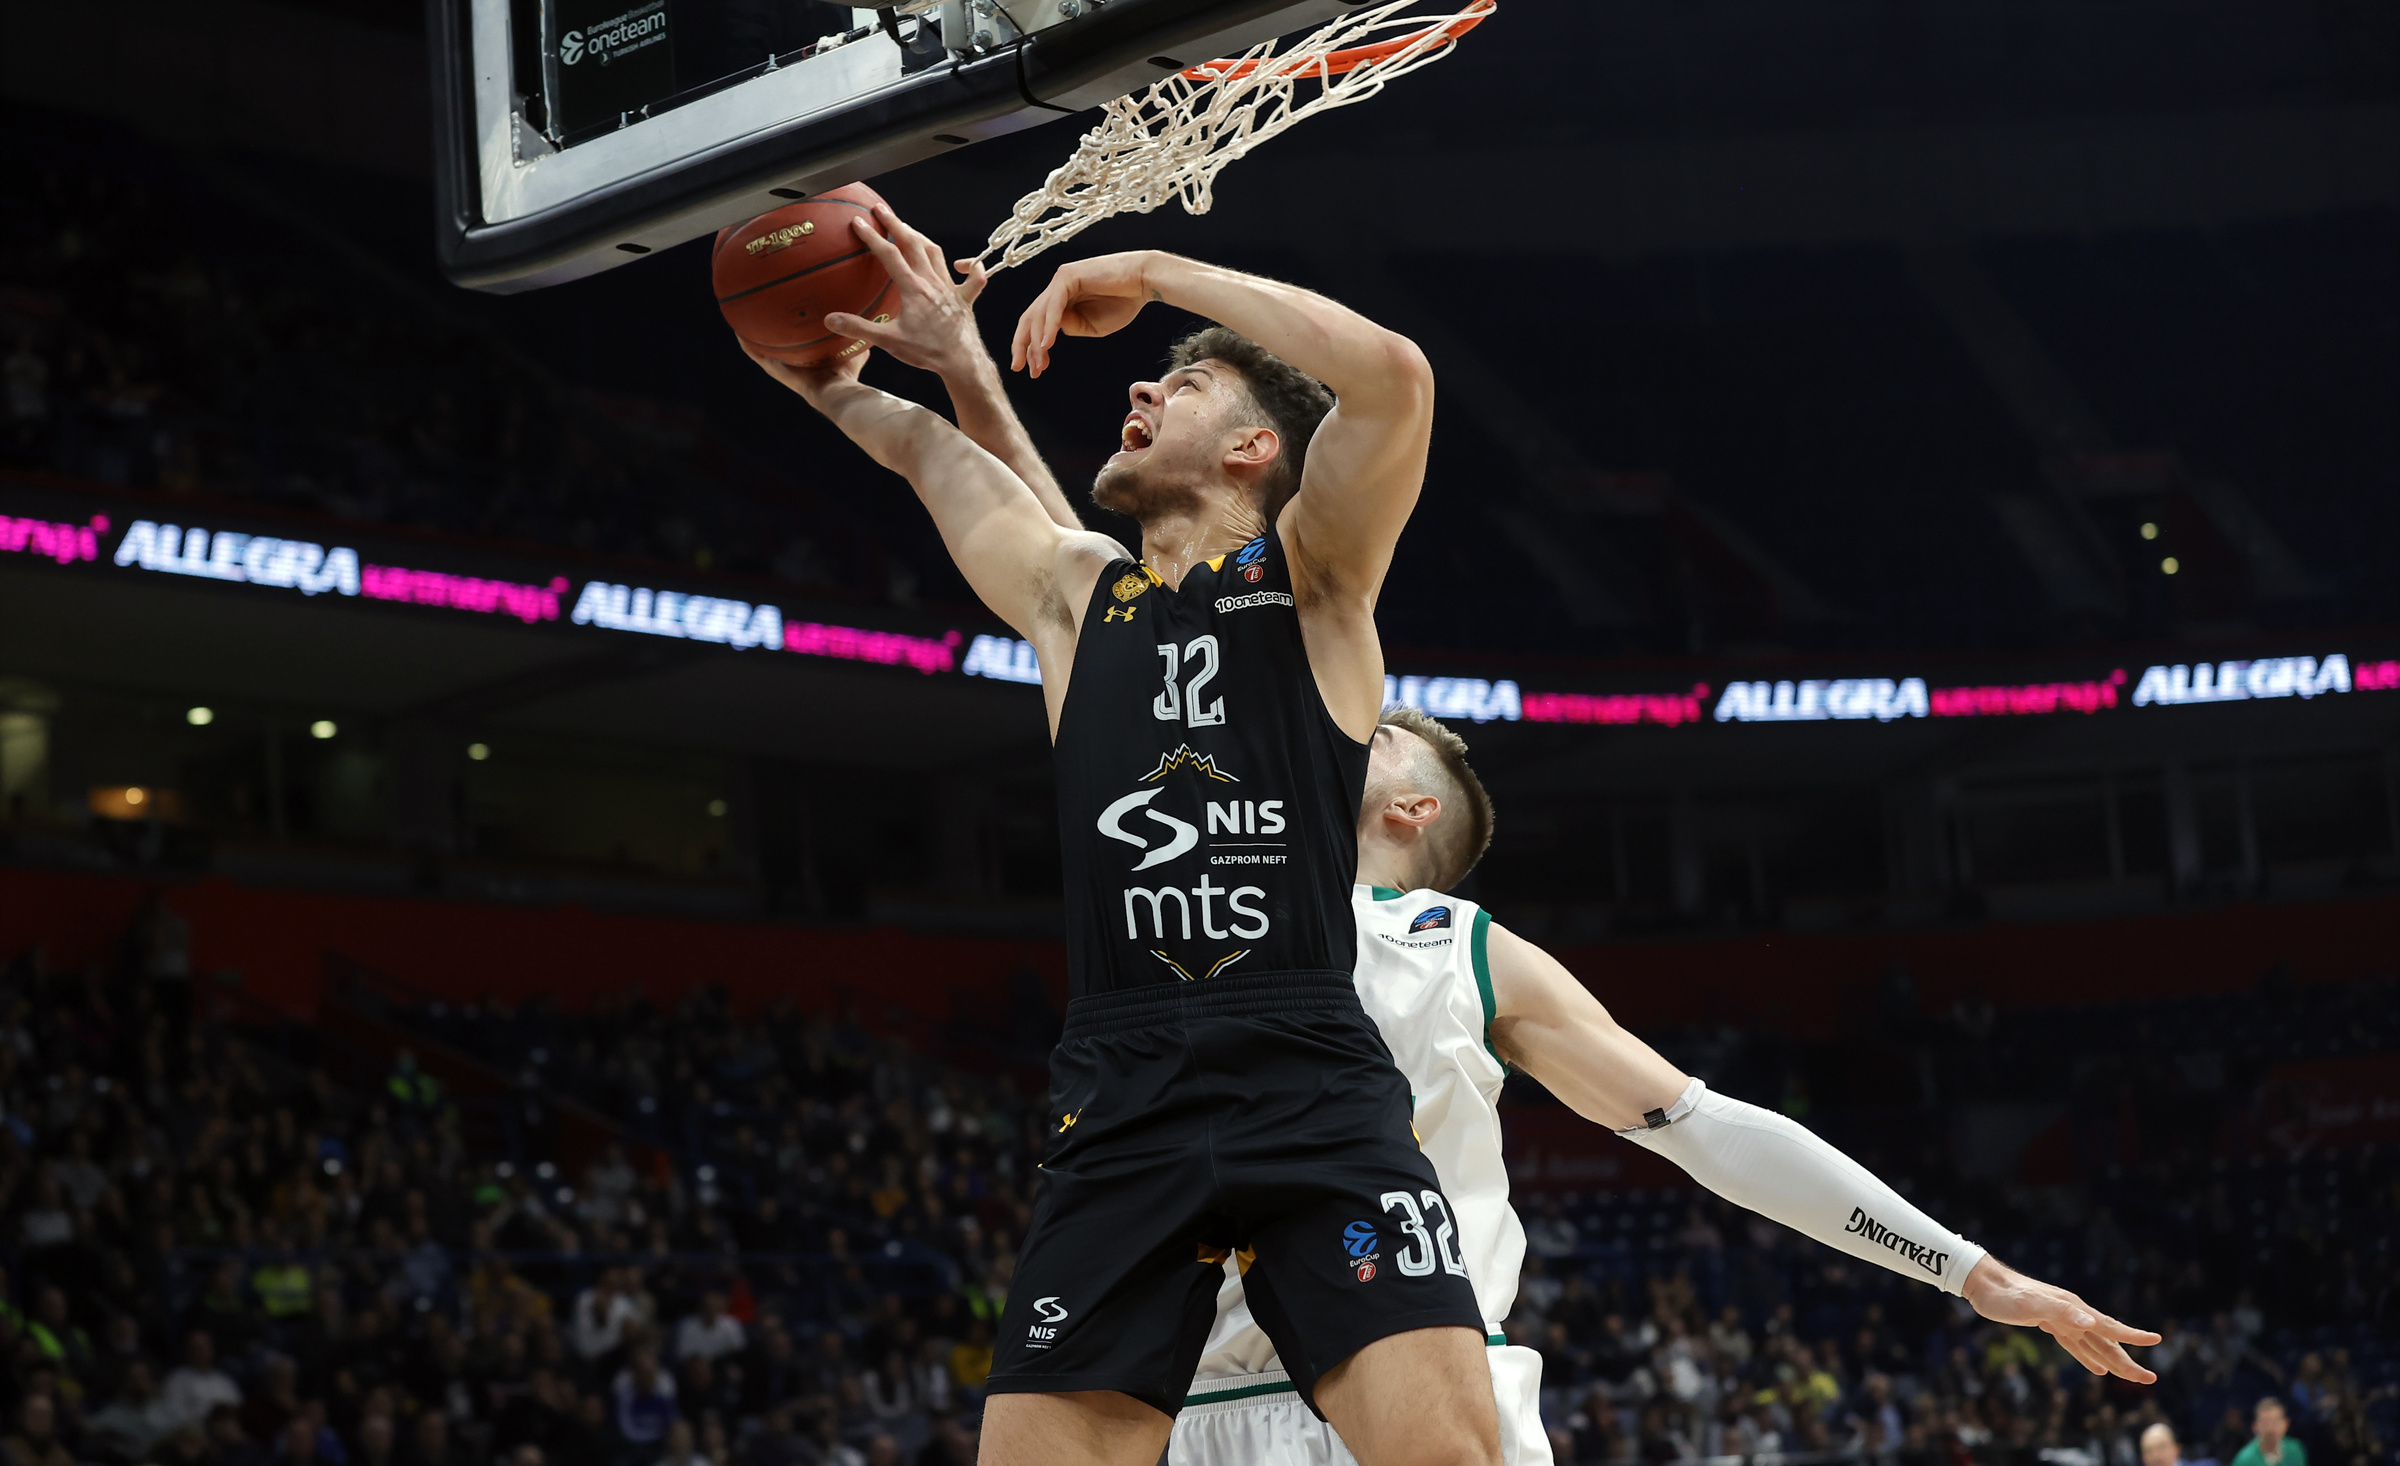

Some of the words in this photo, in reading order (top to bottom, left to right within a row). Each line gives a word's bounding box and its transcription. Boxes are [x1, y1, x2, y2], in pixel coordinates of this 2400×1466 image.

[588, 11, 666, 55] oneteam
[745, 221, 815, 255] TF-1000
[114, 520, 361, 596] ALLEGRA
[1237, 556, 1267, 572] EuroCup
[571, 580, 784, 650] ALLEGRA
[1215, 591, 1293, 613] 10oneteam
[1153, 634, 1226, 728] 32
[1383, 674, 1521, 724] LEGRA
[1714, 678, 1929, 722] ALLEGRA
[2132, 653, 2352, 707] ALLEGRA
[1207, 800, 1287, 835] NIS
[1210, 855, 1261, 865] GAZPROM
[1262, 855, 1288, 865] NEFT
[1123, 873, 1270, 940] mts
[1380, 1189, 1469, 1280] 32
[1844, 1206, 1949, 1276] SPALDING
[1349, 1252, 1380, 1268] EuroCup
[1028, 1325, 1058, 1340] NIS
